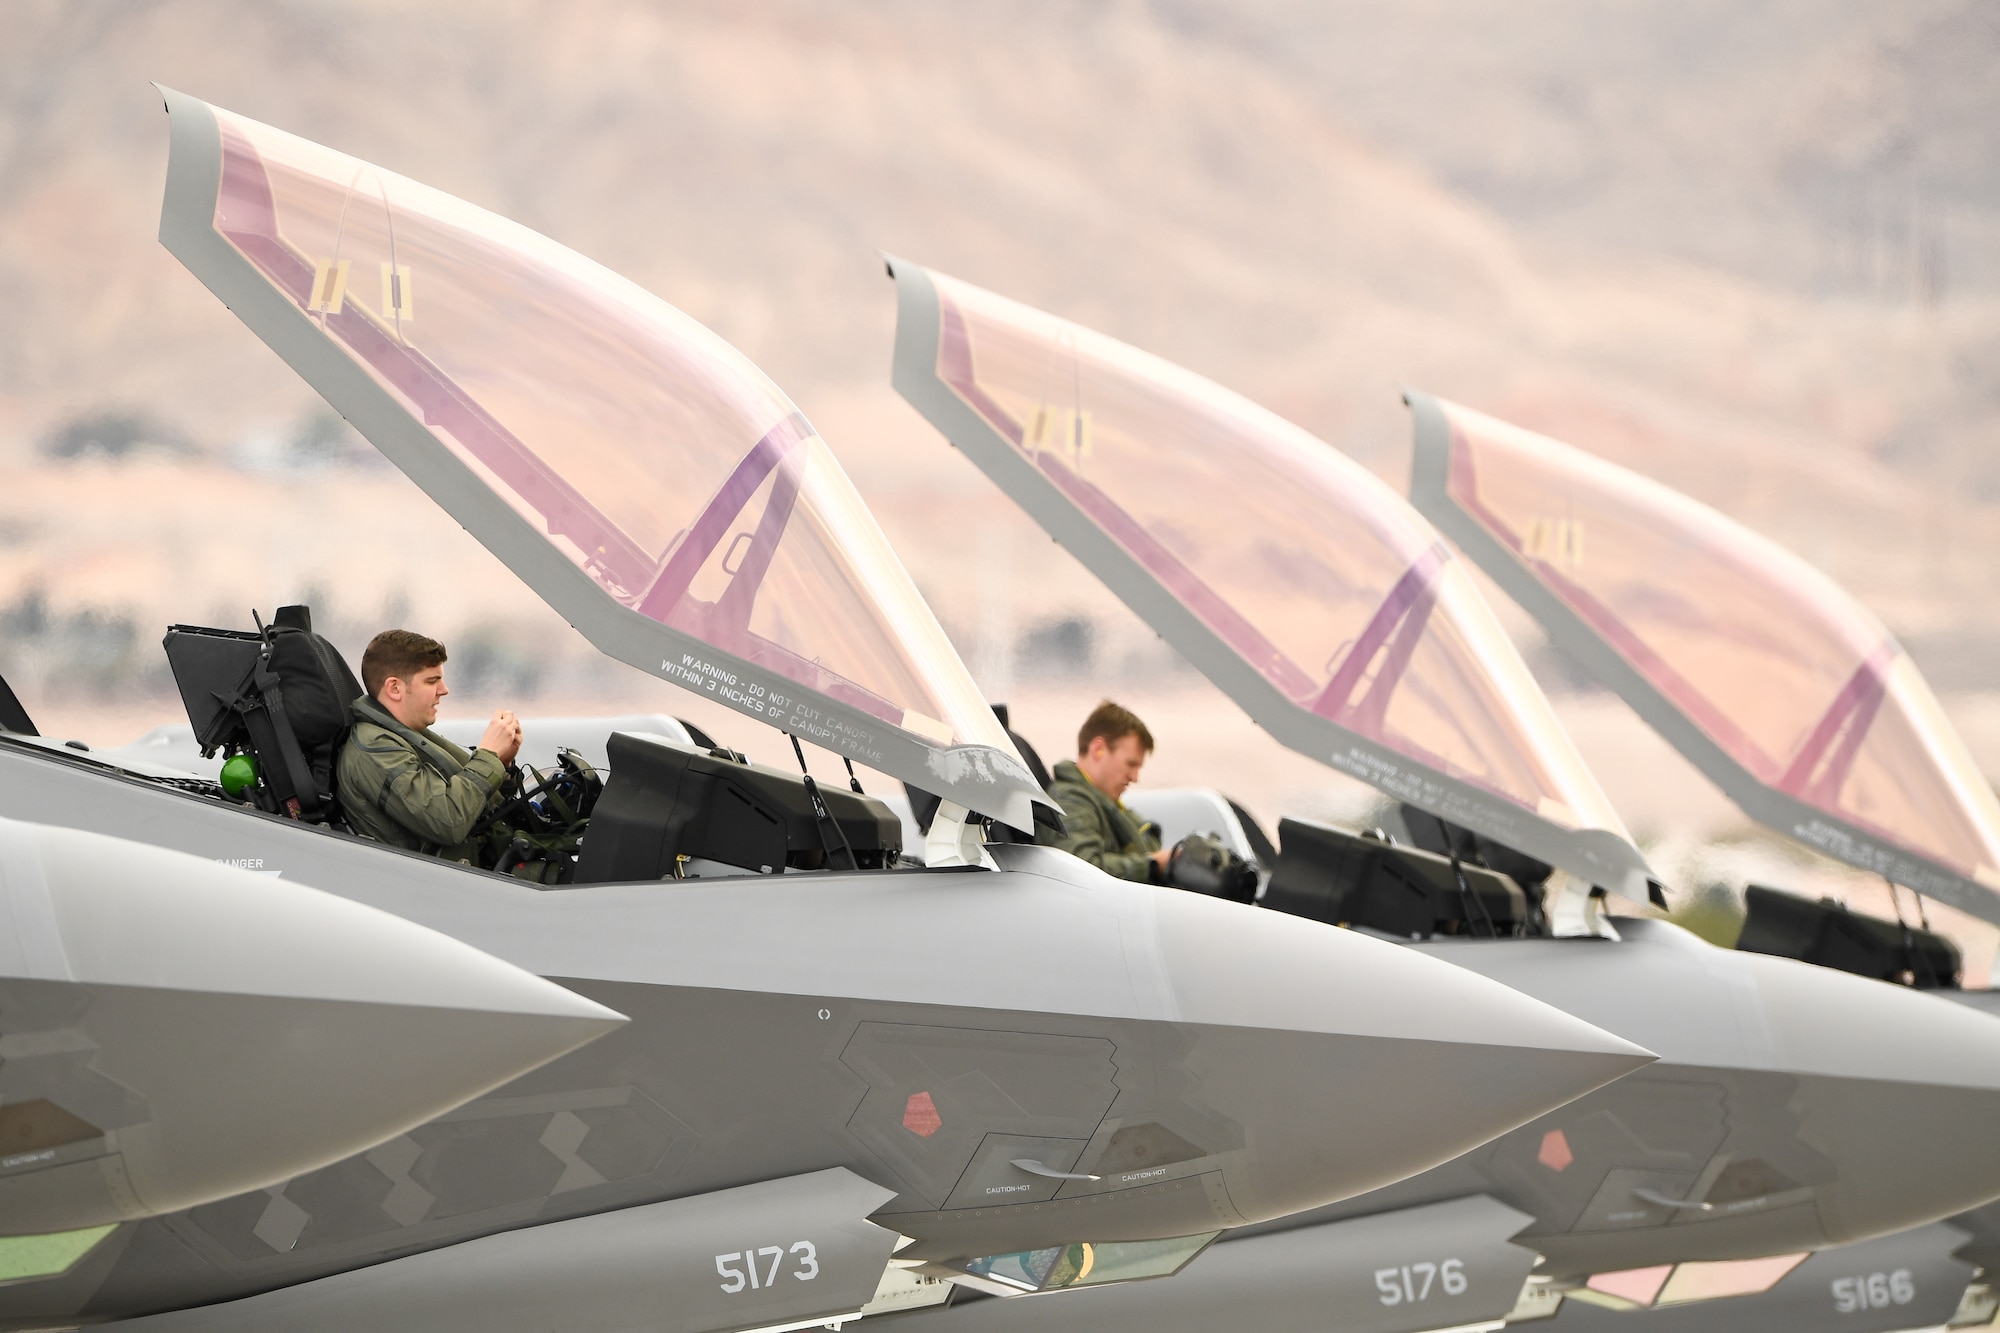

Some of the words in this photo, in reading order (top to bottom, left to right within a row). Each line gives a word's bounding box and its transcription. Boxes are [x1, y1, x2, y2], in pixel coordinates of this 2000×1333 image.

[661, 659, 704, 686] WITHIN
[706, 680, 717, 691] 3
[719, 685, 765, 712] INCHES
[768, 706, 785, 719] OF
[789, 715, 838, 743] CANOPY
[841, 737, 884, 762] FRAME
[682, 654, 738, 685] WARNING
[748, 683, 765, 697] DO
[768, 692, 792, 708] NOT
[796, 704, 821, 720] CUT
[826, 717, 876, 744] CANOPY
[986, 1184, 1031, 1195] CAUTION-HOT
[1122, 1168, 1167, 1182] CAUTION-HOT
[715, 1240, 819, 1294] 5173
[1374, 1258, 1468, 1307] 5176
[1831, 1268, 1915, 1313] 5166
